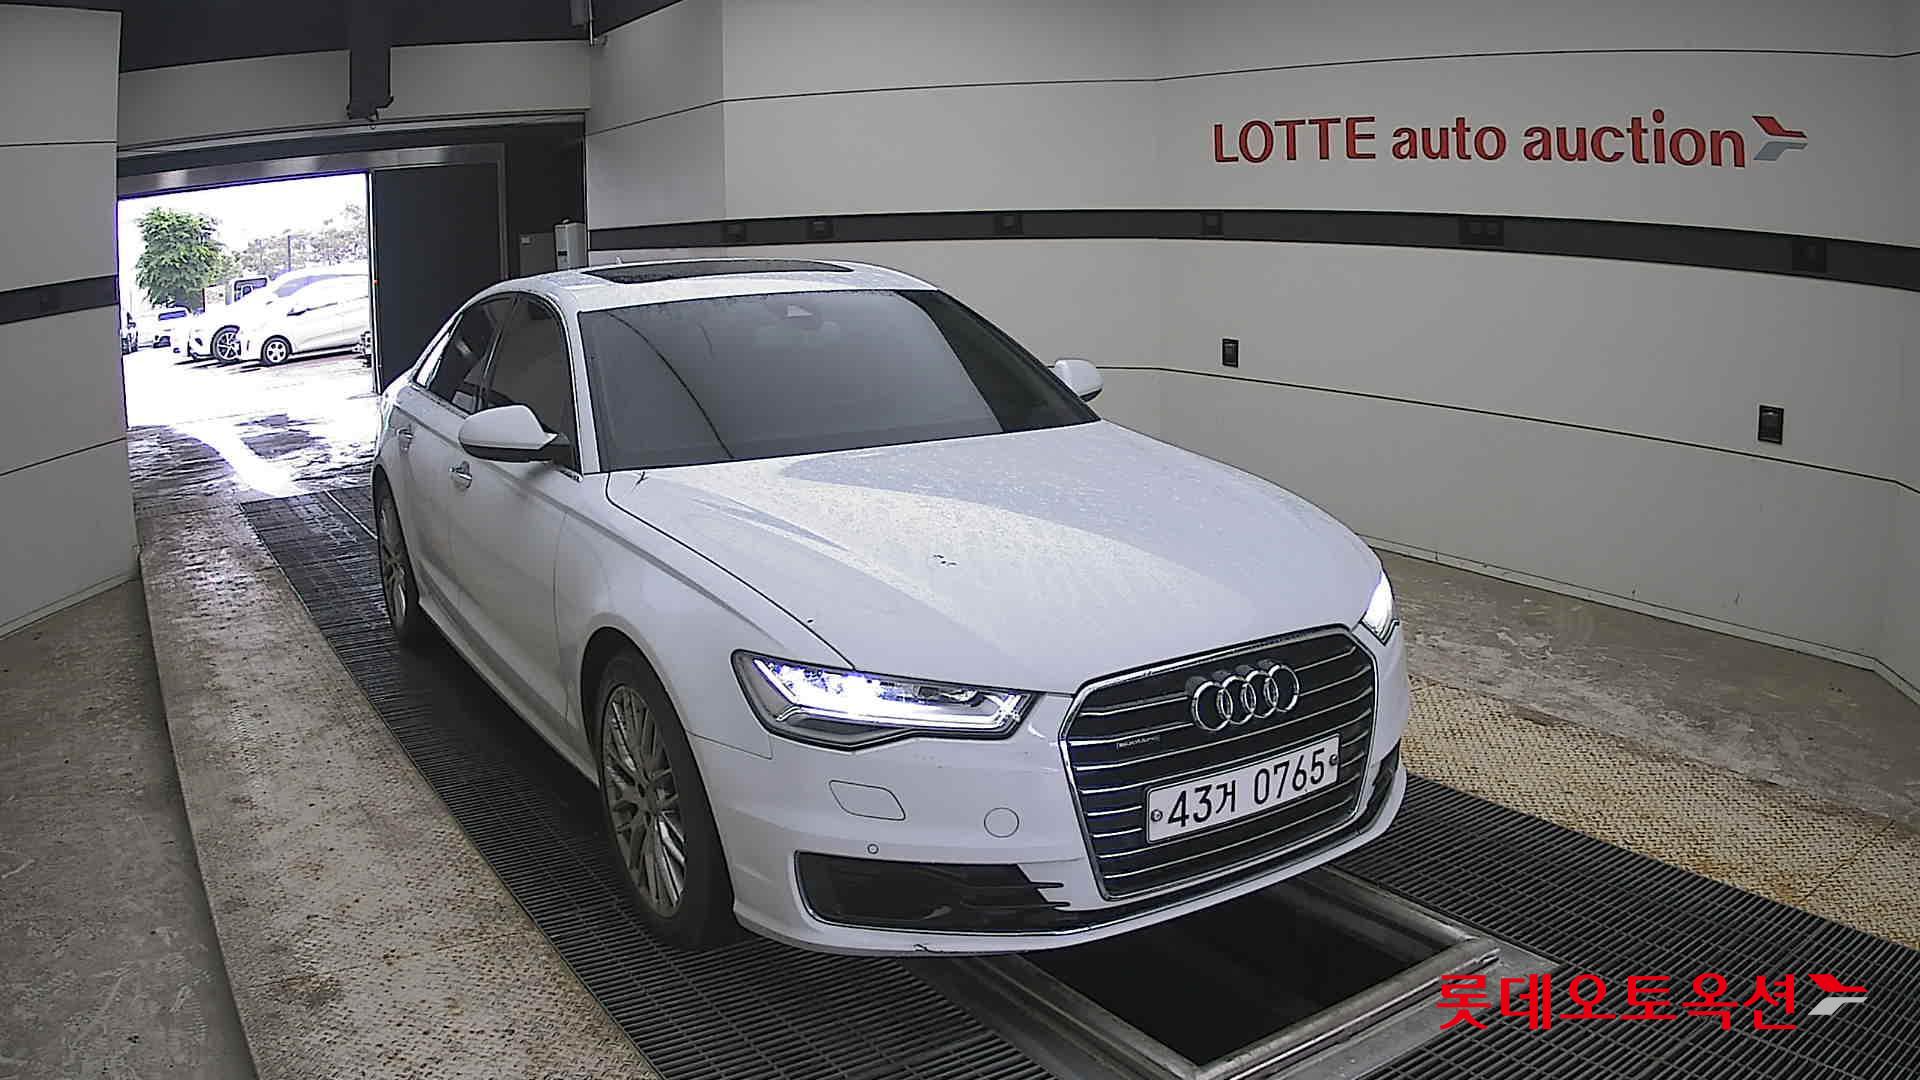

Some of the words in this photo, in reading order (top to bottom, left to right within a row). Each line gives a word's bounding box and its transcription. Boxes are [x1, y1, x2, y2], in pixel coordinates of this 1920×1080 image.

[1214, 116, 1376, 163] LOTTE
[1391, 117, 1506, 161] auto
[1523, 109, 1745, 168] auction
[1168, 779, 1236, 827] 43거
[1254, 748, 1325, 805] 0765
